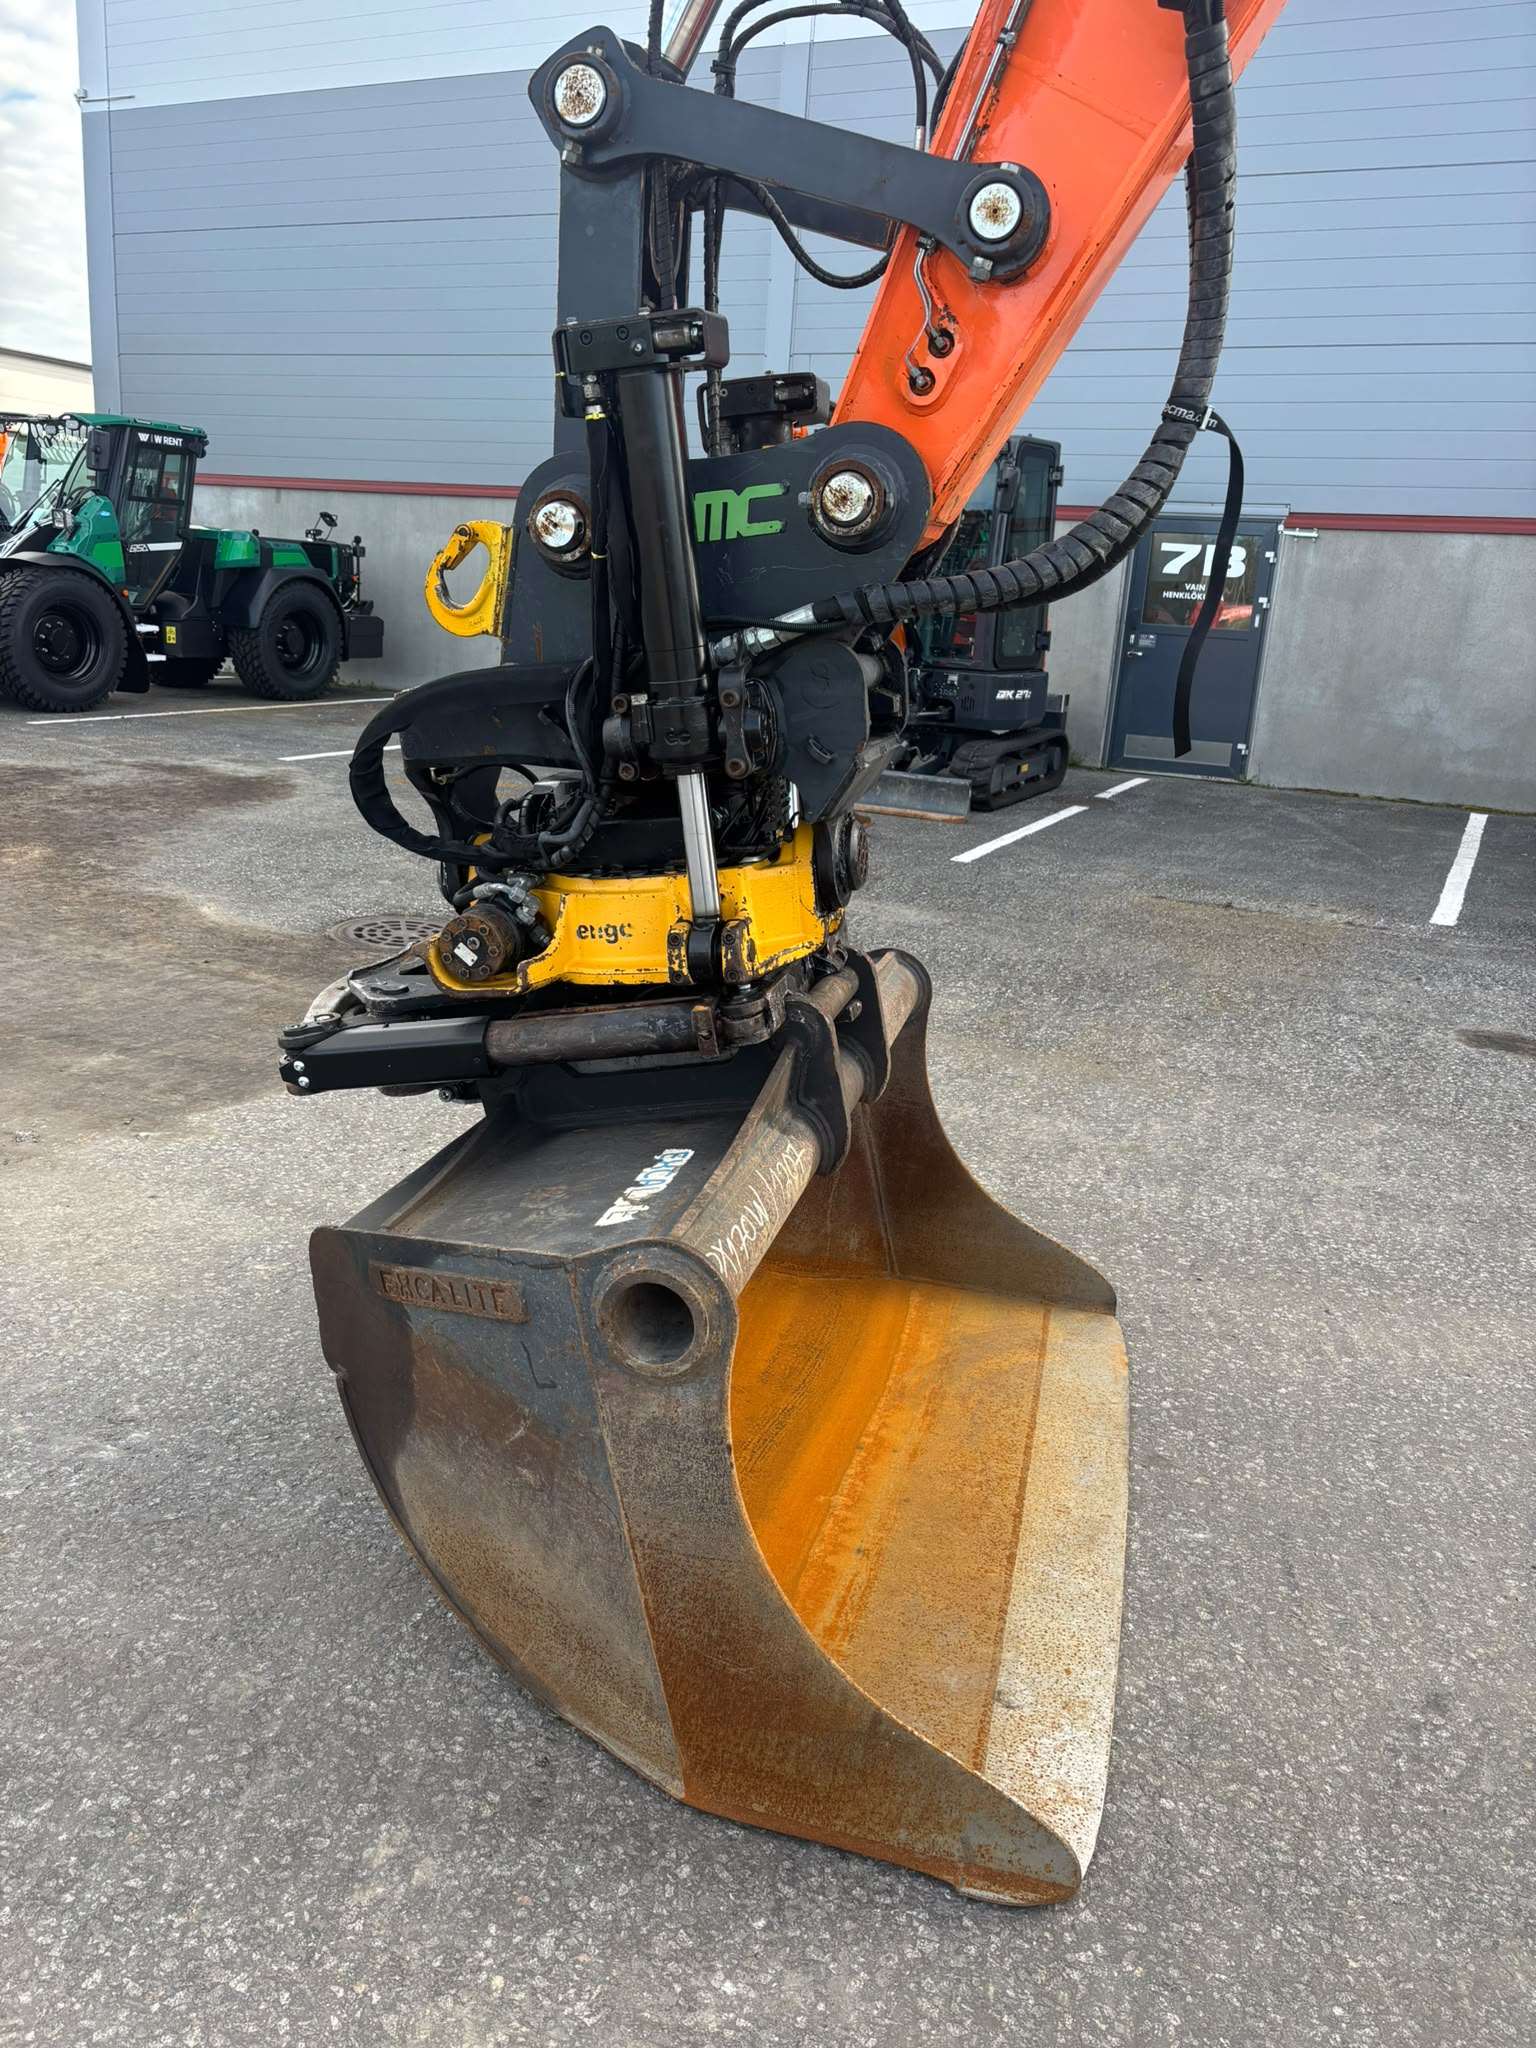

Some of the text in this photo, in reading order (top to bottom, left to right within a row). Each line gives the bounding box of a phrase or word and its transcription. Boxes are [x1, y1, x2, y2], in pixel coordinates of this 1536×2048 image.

[1161, 542, 1247, 578] 7B
[1185, 583, 1206, 591] VAIN
[379, 1269, 508, 1315] EXCALITE
